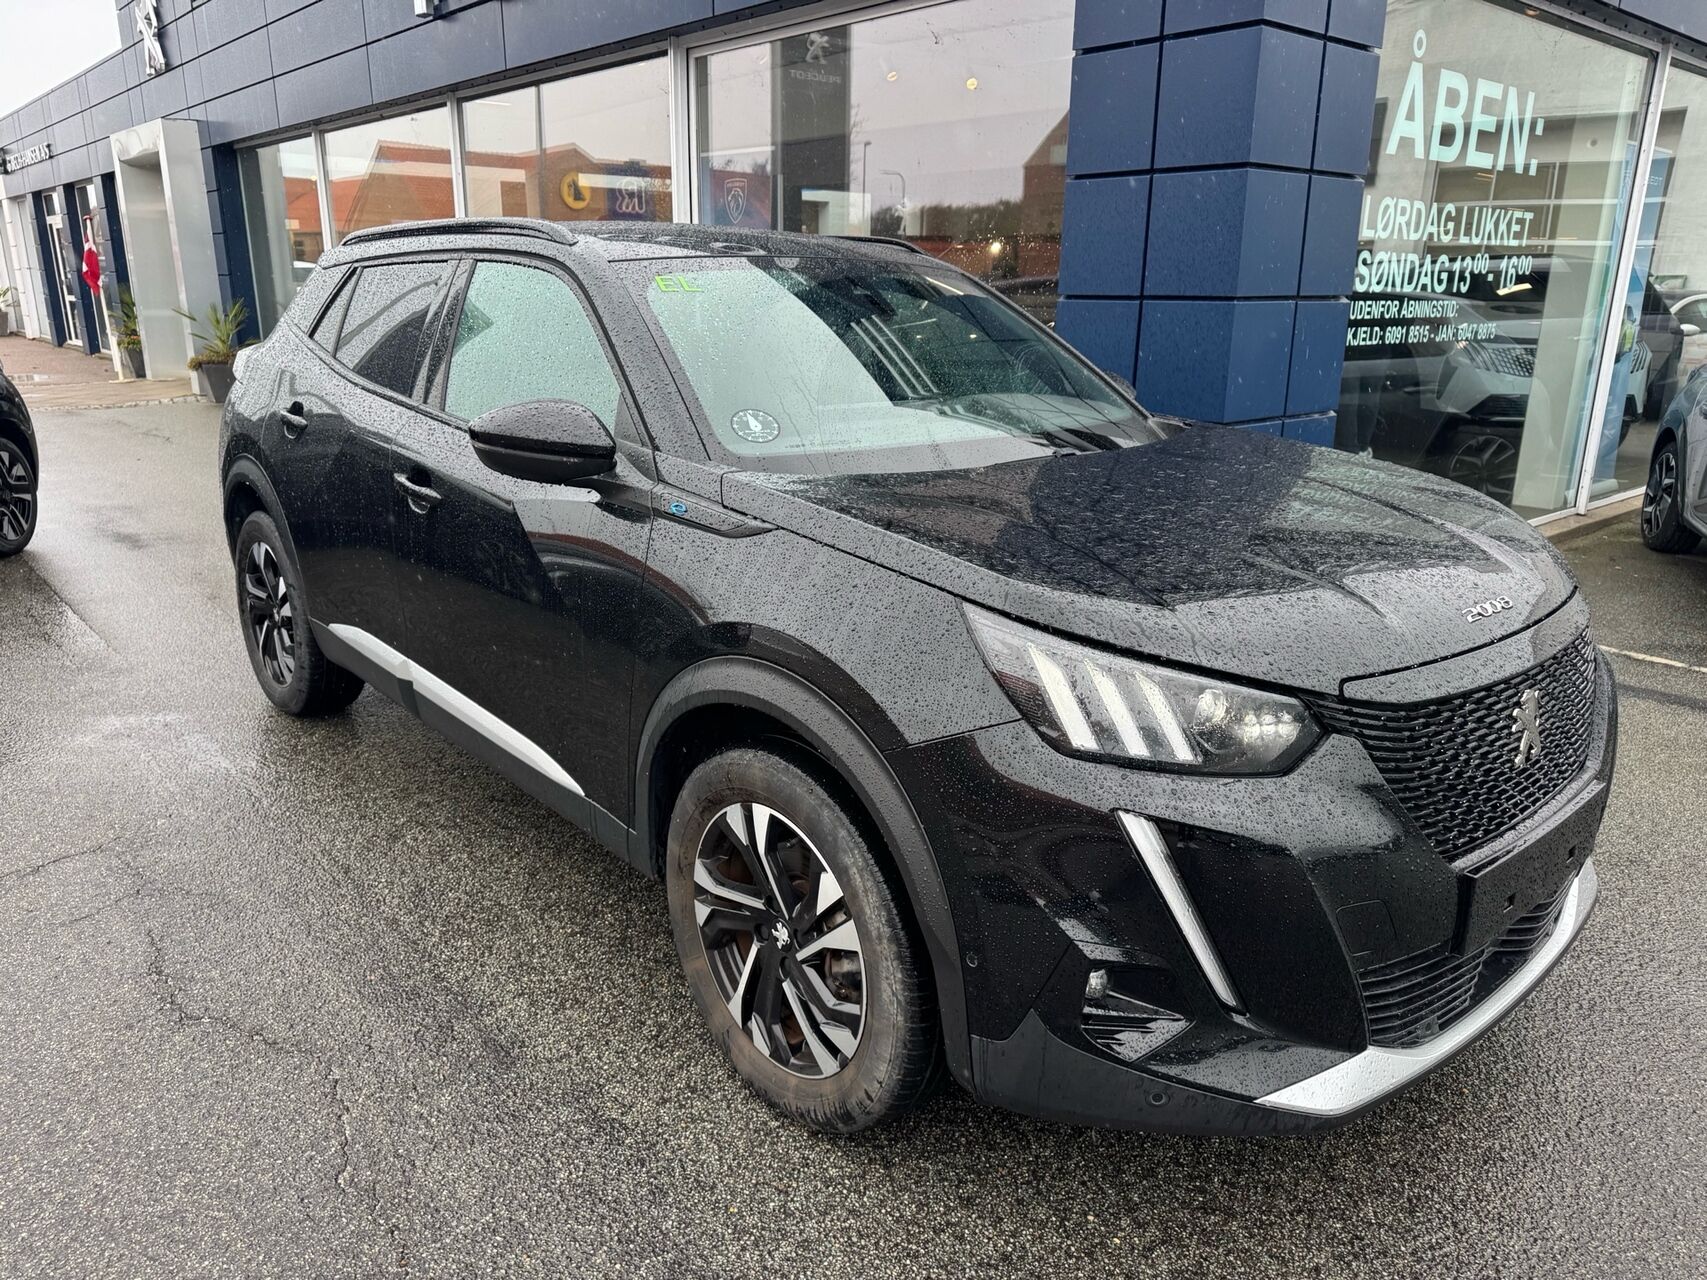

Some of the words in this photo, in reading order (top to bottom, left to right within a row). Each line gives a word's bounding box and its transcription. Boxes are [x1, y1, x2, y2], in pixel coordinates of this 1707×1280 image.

[1386, 29, 1545, 176] ÅBEN:
[1361, 195, 1456, 243] LØRDAG
[1459, 206, 1534, 247] LUKKET
[655, 275, 704, 292] EL
[1355, 250, 1449, 294] SØNDAG
[1350, 300, 1399, 320] UDENFOR
[1400, 297, 1459, 319] ÅBNINGSTID:
[1346, 327, 1383, 346] KJELD:
[1384, 326, 1407, 345] 6091
[1408, 325, 1430, 343] 8515
[1435, 324, 1457, 342] JAN:
[1462, 596, 1513, 623] 2008
